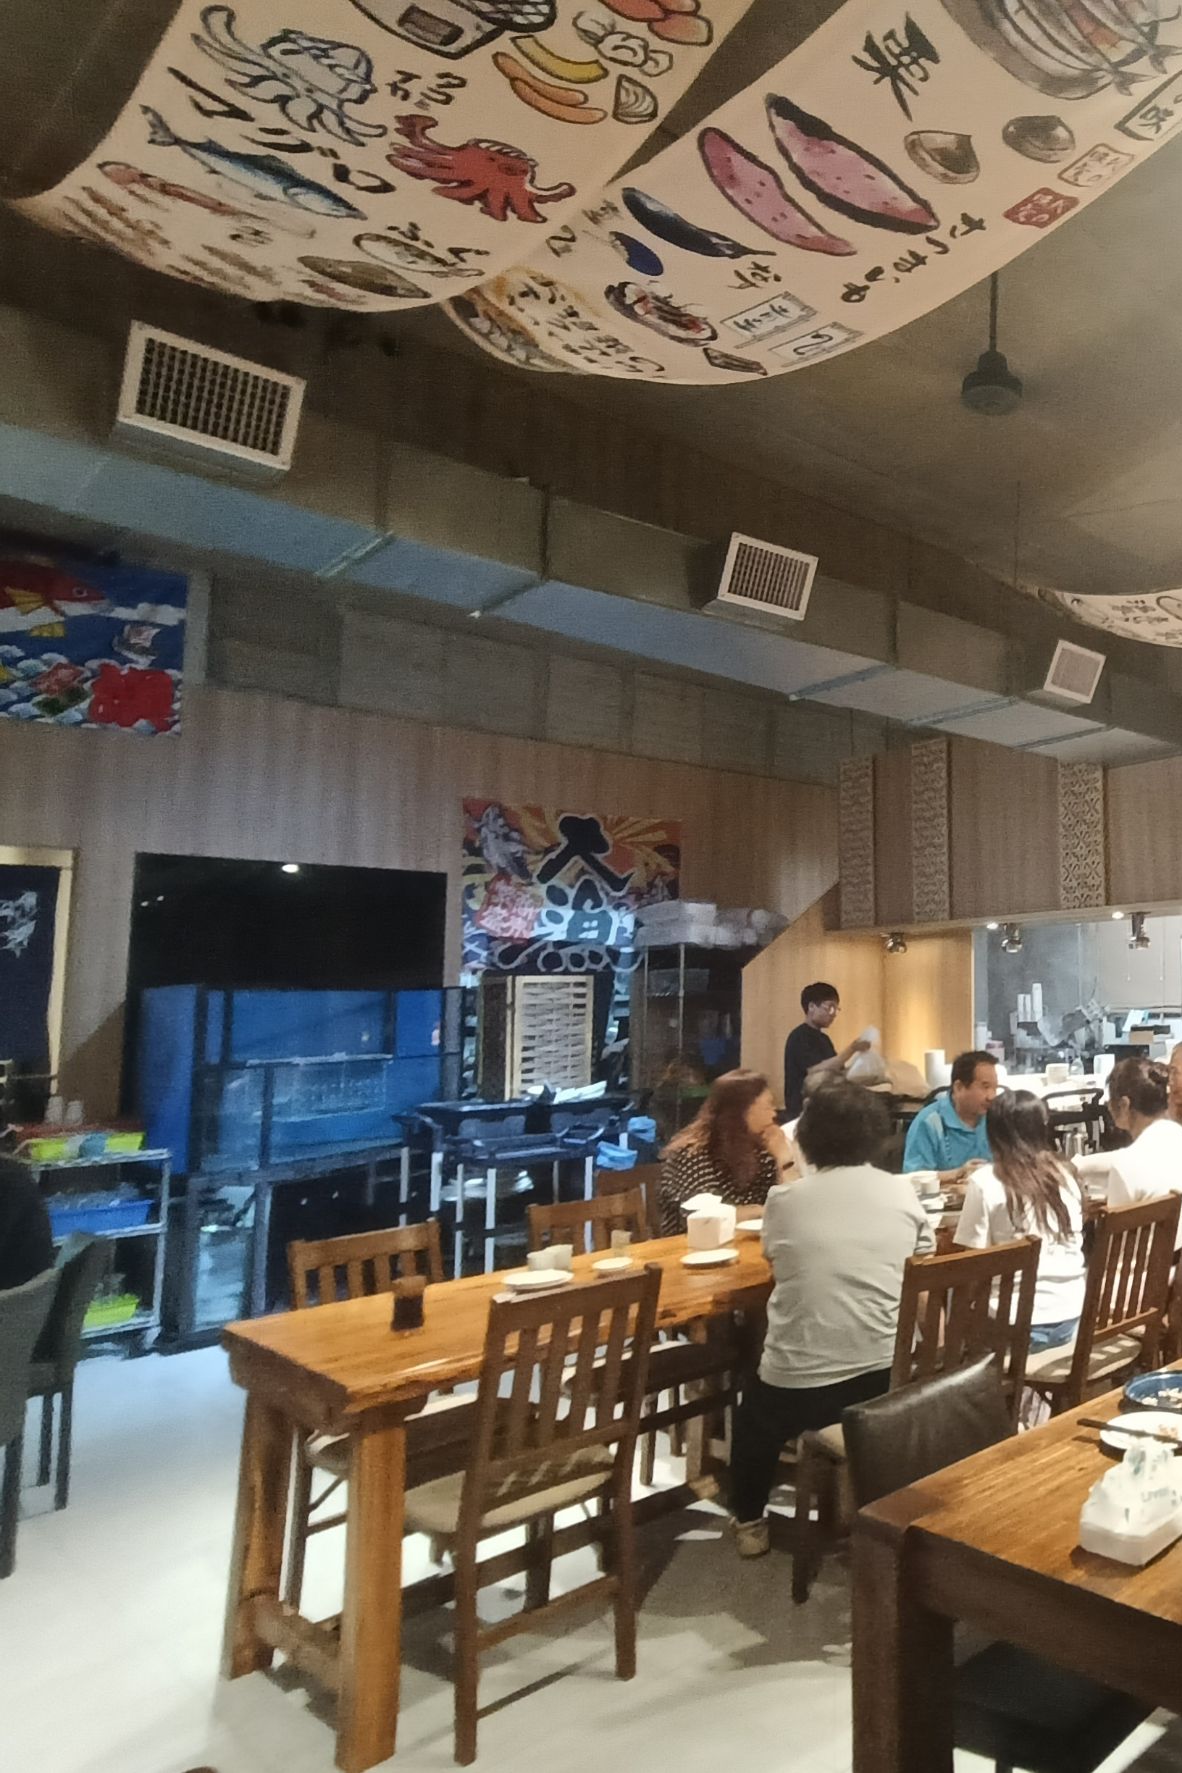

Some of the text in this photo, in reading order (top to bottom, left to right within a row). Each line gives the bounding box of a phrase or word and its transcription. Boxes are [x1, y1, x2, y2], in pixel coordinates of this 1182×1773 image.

[852, 11, 940, 122] 栗
[168, 66, 397, 194] マグロ
[841, 212, 987, 304] さつまいも
